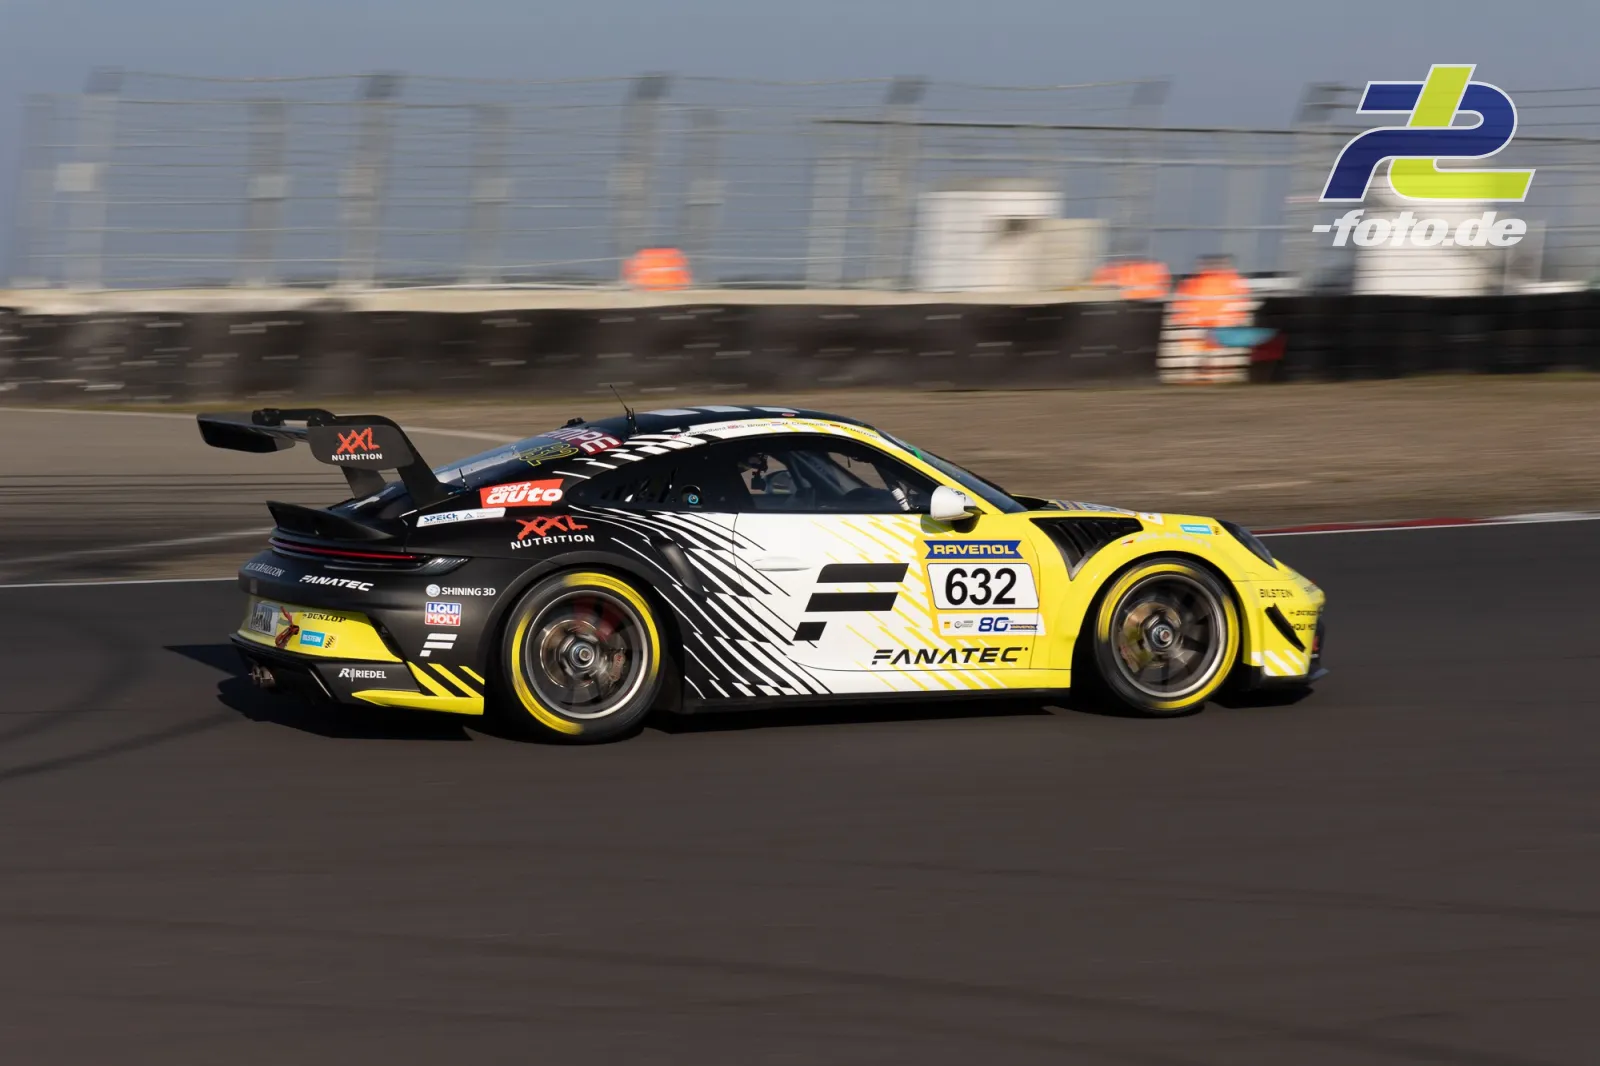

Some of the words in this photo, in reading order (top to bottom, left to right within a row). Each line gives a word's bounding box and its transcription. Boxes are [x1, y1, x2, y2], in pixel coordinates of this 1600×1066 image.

[336, 427, 380, 454] XXL
[331, 453, 383, 461] NUTRITION
[491, 482, 531, 493] sport
[486, 488, 563, 505] auto
[516, 515, 588, 540] XXL
[510, 534, 595, 550] NUTRITION
[933, 544, 1015, 555] RAVENOL
[299, 575, 374, 592] FANATEC
[945, 568, 1017, 605] 632
[441, 587, 482, 597] SHINING
[482, 587, 496, 597] 3D
[1259, 588, 1294, 598] BILSTEIN
[428, 603, 459, 614] LIQUI
[306, 612, 347, 623] DUNLOP
[427, 613, 459, 625] MOLY
[978, 617, 1010, 632] 80
[872, 647, 1025, 665] FANATEC
[355, 669, 387, 679] RIEDEL
